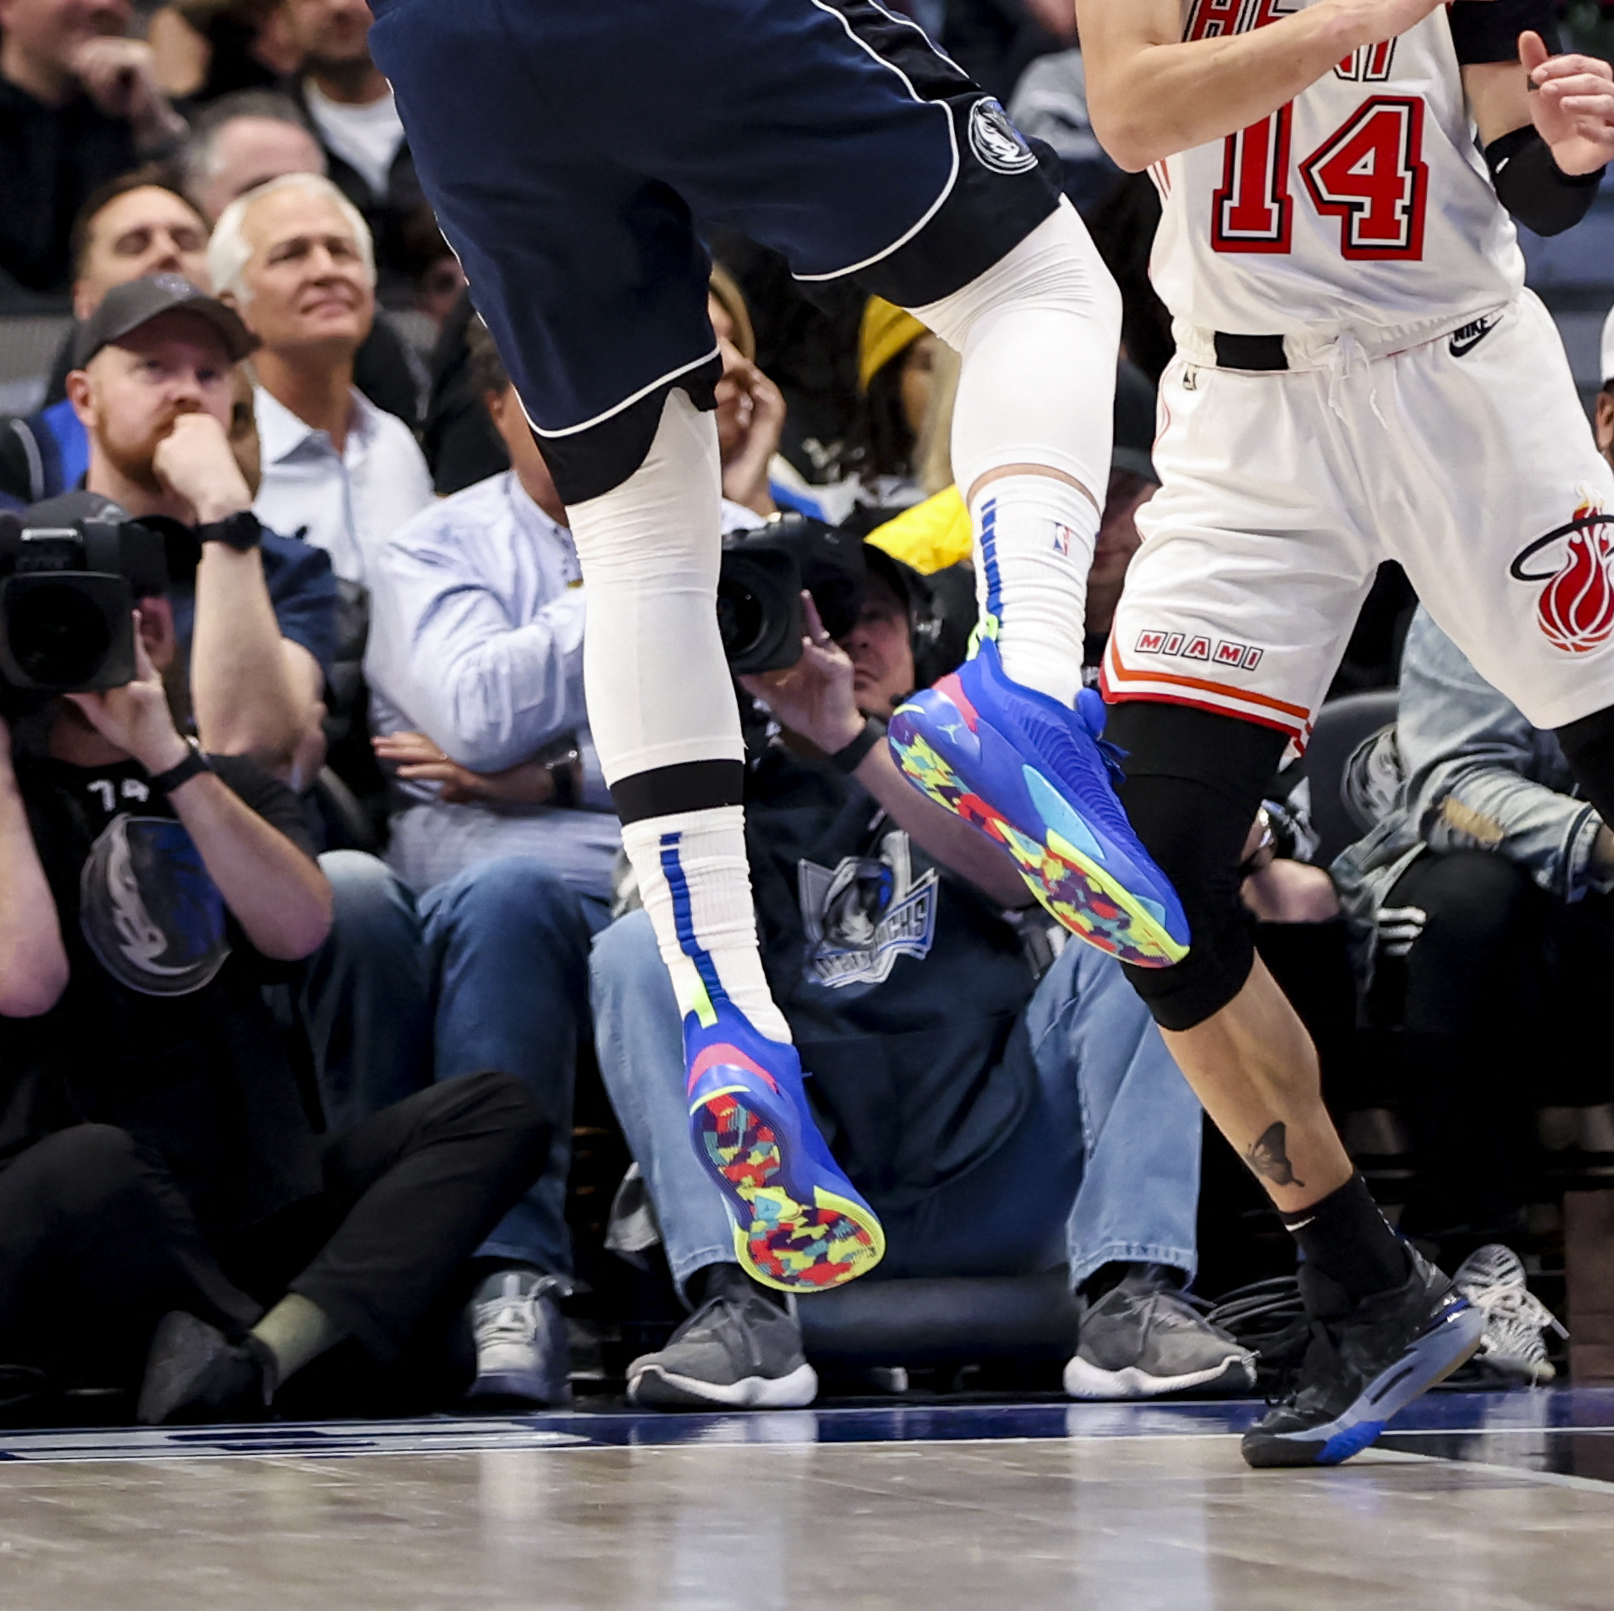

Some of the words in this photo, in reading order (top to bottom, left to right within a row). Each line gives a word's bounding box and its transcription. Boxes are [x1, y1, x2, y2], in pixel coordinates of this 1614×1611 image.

[1211, 95, 1429, 261] 14
[1452, 315, 1492, 343] NIKE
[1134, 629, 1264, 671] MIAMI
